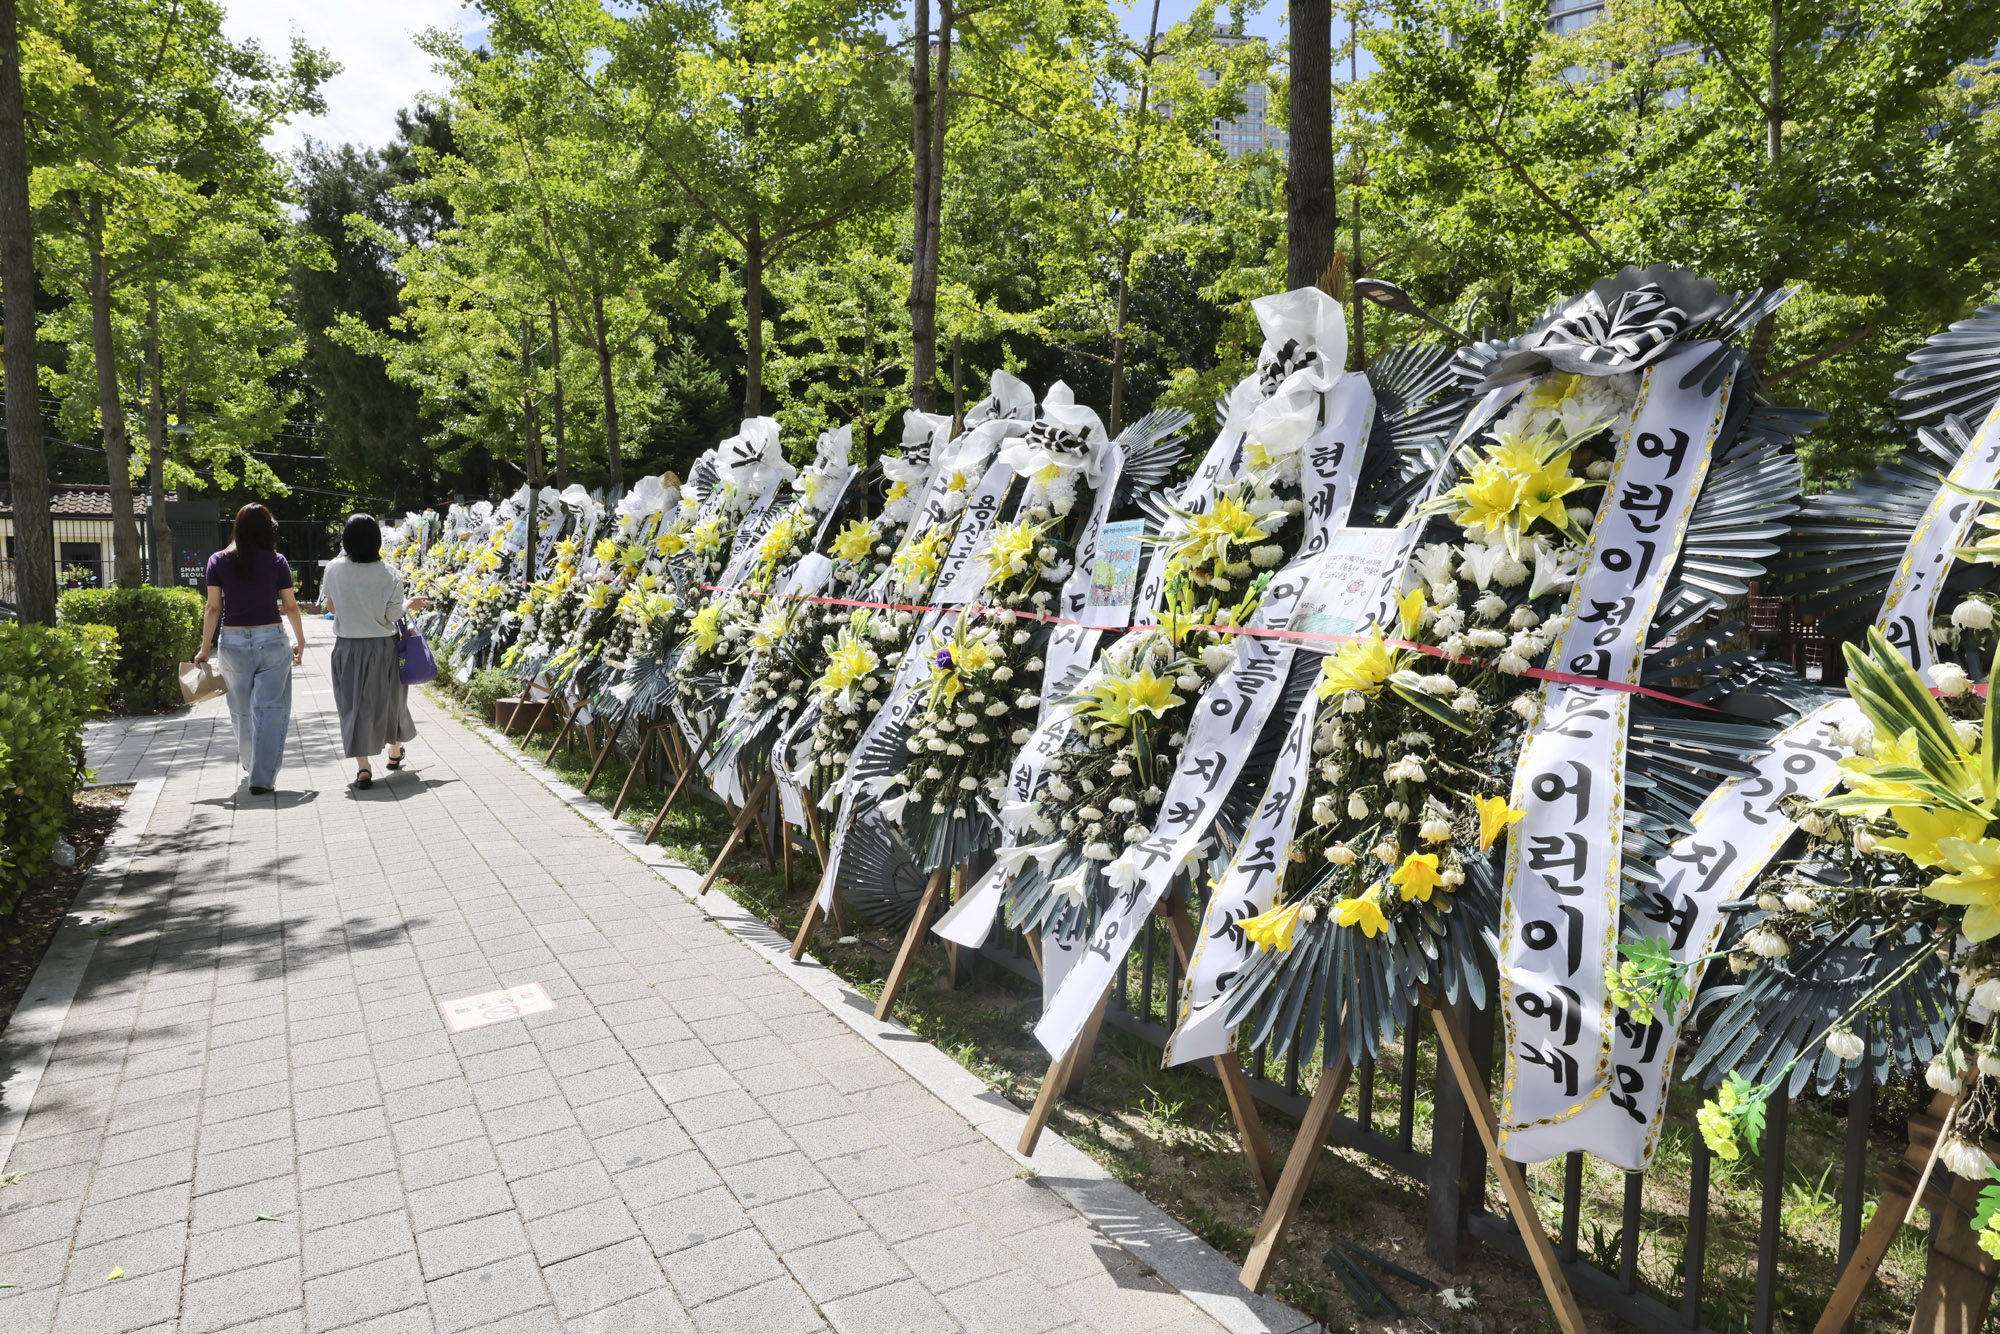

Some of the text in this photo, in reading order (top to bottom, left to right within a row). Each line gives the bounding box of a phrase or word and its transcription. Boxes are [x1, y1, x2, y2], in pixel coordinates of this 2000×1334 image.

[1089, 442, 1346, 962] 현재의 어른들이 지켜주세요
[1515, 760, 1592, 1097] 어린이에게
[1611, 840, 1738, 1124] 지켜세요
